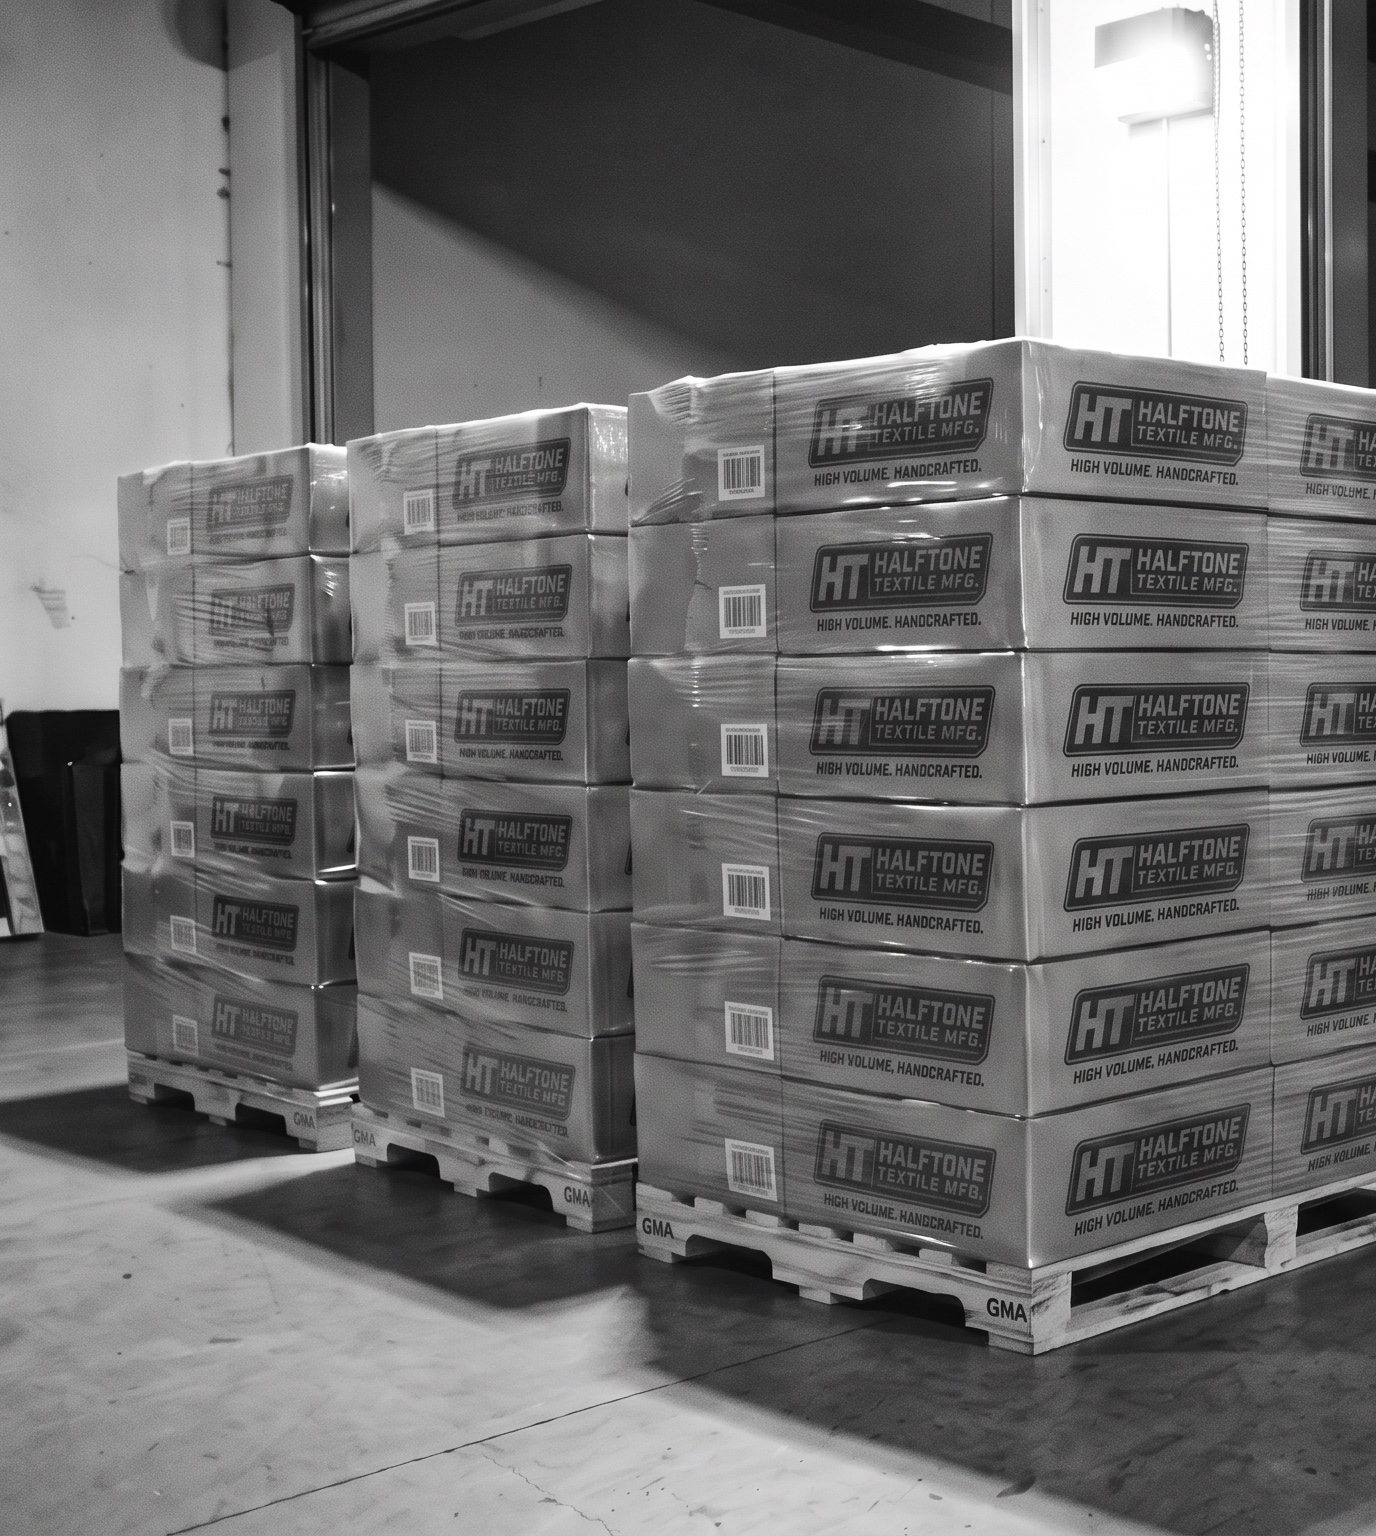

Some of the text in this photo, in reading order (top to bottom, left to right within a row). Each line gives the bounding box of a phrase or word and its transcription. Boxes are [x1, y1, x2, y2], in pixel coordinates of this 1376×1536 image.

[874, 392, 983, 426] HALFTONE
[1074, 394, 1132, 443] HT
[1139, 401, 1241, 433] HALFTONE
[817, 405, 868, 456] HT
[875, 420, 979, 443] TEXTILE MFG.
[1138, 426, 1238, 449] TEXTILE MFG.
[1308, 424, 1354, 470] HT
[459, 460, 492, 499] HT
[814, 458, 982, 486] HIGH VOLUME. HANDCRAFTED.
[1071, 459, 1238, 486] HIGH VOLUME. HANDCRAFTED.
[875, 546, 983, 574] HALFTONE
[1073, 546, 1132, 594] HT
[1137, 549, 1241, 575] HALFTONE
[497, 574, 566, 596] HALFTONE
[818, 554, 870, 601] HT
[875, 573, 979, 592] TEXTILE MFG.
[1138, 574, 1238, 592] TEXTILE MFG.
[1308, 560, 1355, 602] HT
[461, 580, 494, 617] HT
[845, 616, 892, 630] VOLUME.
[895, 612, 981, 628] HANDCRAFTED.
[1071, 612, 1238, 628] HIGH VOLUME. HANDCRAFTED.
[461, 699, 494, 735] HT
[497, 698, 564, 716] HALFTONE
[875, 698, 985, 721] HALFTONE
[1074, 696, 1135, 745] HT
[1139, 694, 1241, 717] HALFTONE
[1309, 693, 1355, 736] HT
[818, 699, 871, 745] HT
[875, 725, 982, 741] TEXTILE MFG.
[1138, 719, 1238, 735] TEXTILE MFG.
[846, 763, 892, 776] VOLUME.
[896, 764, 982, 779] HANDCRAFTED.
[1072, 756, 1239, 778] HIGH VOLUME. HANDCRAFTED.
[463, 818, 496, 856] HT
[499, 821, 566, 843] HALFTONE
[877, 848, 985, 876] HALFTONE
[1139, 836, 1241, 867] HALFTONE
[1310, 826, 1356, 872] HT
[820, 844, 872, 892] HT
[1075, 846, 1134, 898] HT
[1139, 865, 1198, 885] TEXTILE
[877, 874, 982, 895] TEXTILE MFG.
[216, 903, 241, 935] HT
[820, 907, 984, 934] HIGH VOLUME. HANDCRAFTED.
[1073, 916, 1101, 933] HIGH
[1158, 899, 1240, 920] HANDCRAFTED.
[464, 938, 497, 976] HT
[500, 943, 568, 968] HALFTONE
[1139, 977, 1241, 1015] HALFTONE
[1309, 958, 1356, 1008] HT
[822, 988, 873, 1038] HT
[878, 995, 986, 1030] HALFTONE
[1075, 994, 1136, 1052] HT
[1139, 1009, 1198, 1032] TEXTILE
[878, 1020, 982, 1048] TEXTILE MFG.
[466, 1053, 499, 1094] HT
[502, 1061, 570, 1093] HALFTONE
[820, 1050, 845, 1065] HIGH
[897, 1061, 984, 1087] HANDCRAFTED.
[1074, 1067, 1102, 1084] HIGH
[1158, 1039, 1238, 1066] HANDCRAFTED.
[294, 1112, 315, 1129] GMA
[1309, 1088, 1358, 1142] HT
[354, 1129, 376, 1147] GMA
[1139, 1116, 1242, 1161] HALFTONE
[822, 1131, 875, 1182] HT
[879, 1142, 987, 1182] HALFTONE
[1076, 1142, 1136, 1202] HT
[1138, 1151, 1198, 1178] TEXTILE
[878, 1166, 939, 1192] TEXTILE
[564, 1186, 590, 1207] GMA
[1074, 1180, 1238, 1236] HIGH VOLUME. HANDCRAFTED.
[642, 1218, 674, 1239] GMA
[987, 1298, 1027, 1322] GMA
